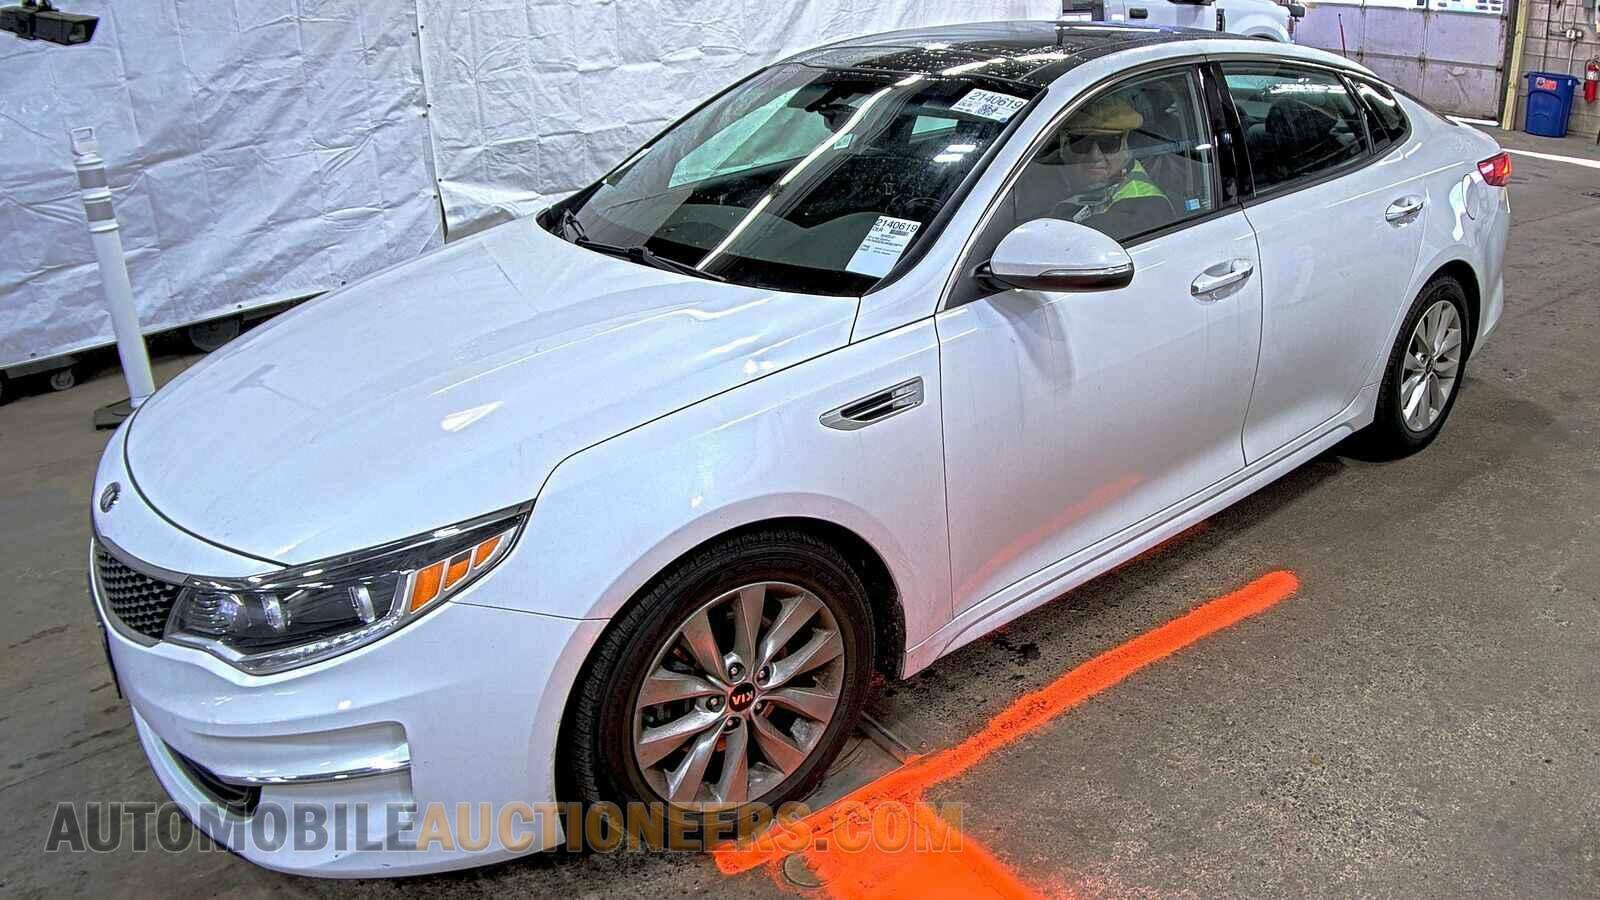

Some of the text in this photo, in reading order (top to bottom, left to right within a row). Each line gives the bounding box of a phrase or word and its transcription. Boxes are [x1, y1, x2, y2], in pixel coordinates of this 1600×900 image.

[968, 91, 1025, 110] 2140619
[875, 218, 919, 233] 2140619
[731, 690, 754, 705] KIA
